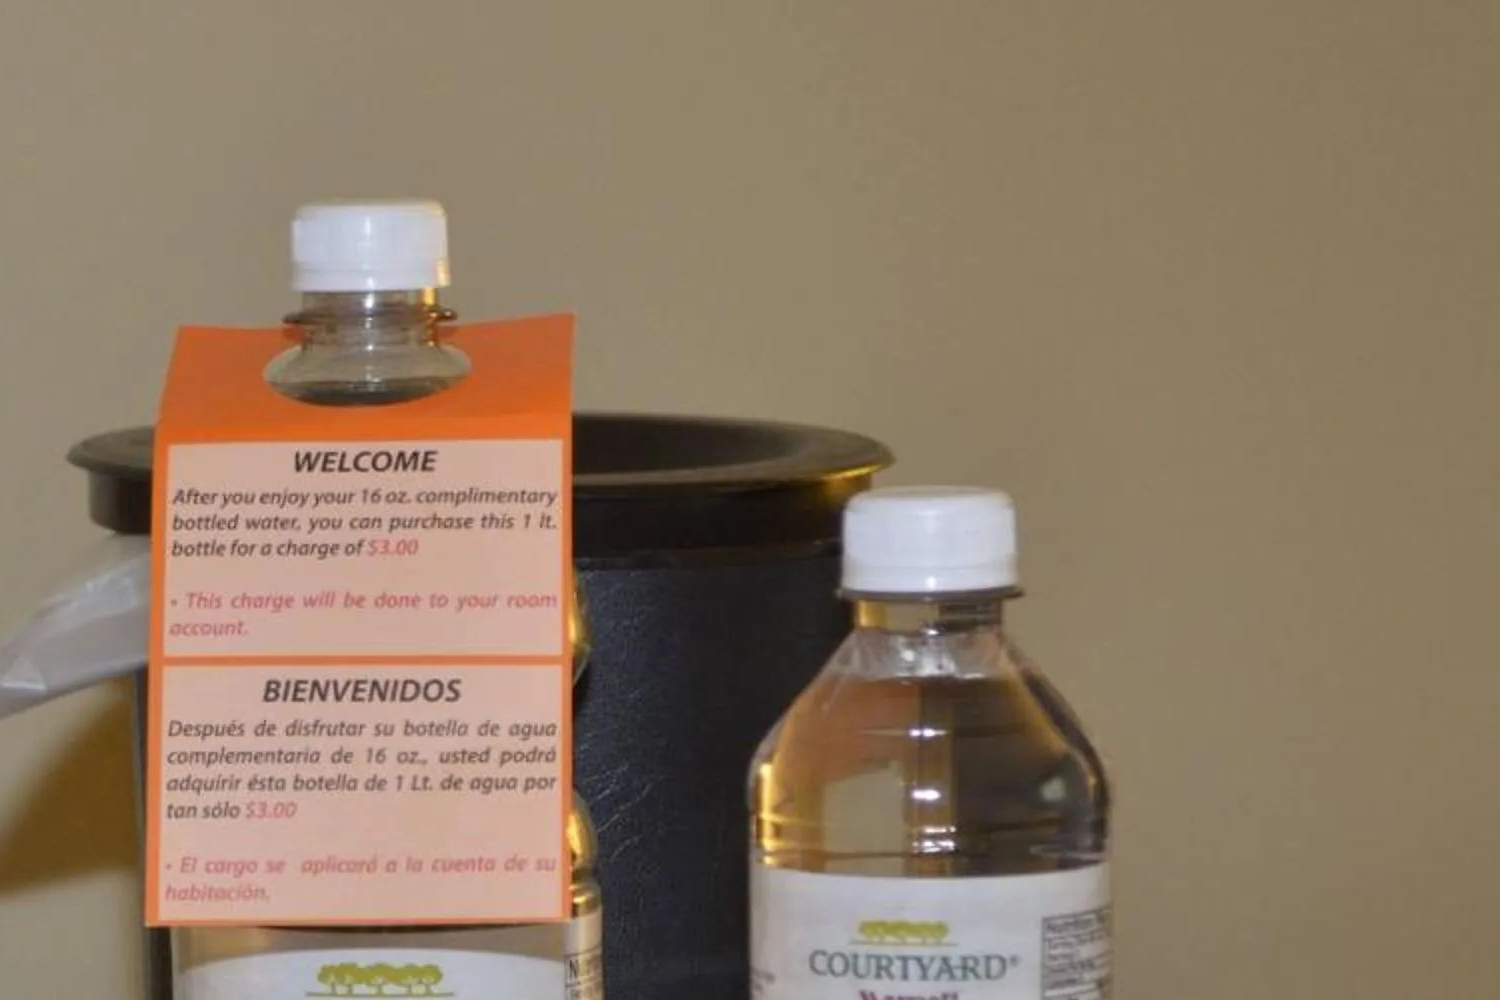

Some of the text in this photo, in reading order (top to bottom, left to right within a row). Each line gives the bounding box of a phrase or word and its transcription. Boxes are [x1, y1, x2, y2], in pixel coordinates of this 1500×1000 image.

[293, 449, 439, 474] WELCOME
[172, 487, 558, 510] After you enjoy your 16 oz. complimentary
[171, 513, 557, 534] bottled water, you can purchase this 1 lt.
[171, 538, 419, 560] bottle for a charge of $3.00
[186, 592, 558, 613] This charge will be done to your room
[169, 620, 250, 637] account.
[262, 678, 463, 704] BIENVENIDOS
[167, 719, 557, 741] Después de disfrutar su botella de agua
[166, 746, 557, 768] complementaria de 16 oz., usted podrá
[166, 774, 557, 796] adquirir ésta botella de 1 Lt. de agua por
[166, 801, 298, 820] tan sólo $3.00
[180, 855, 556, 878] El cargo se aplicará a la cuenta de su
[165, 883, 271, 902] habitación.
